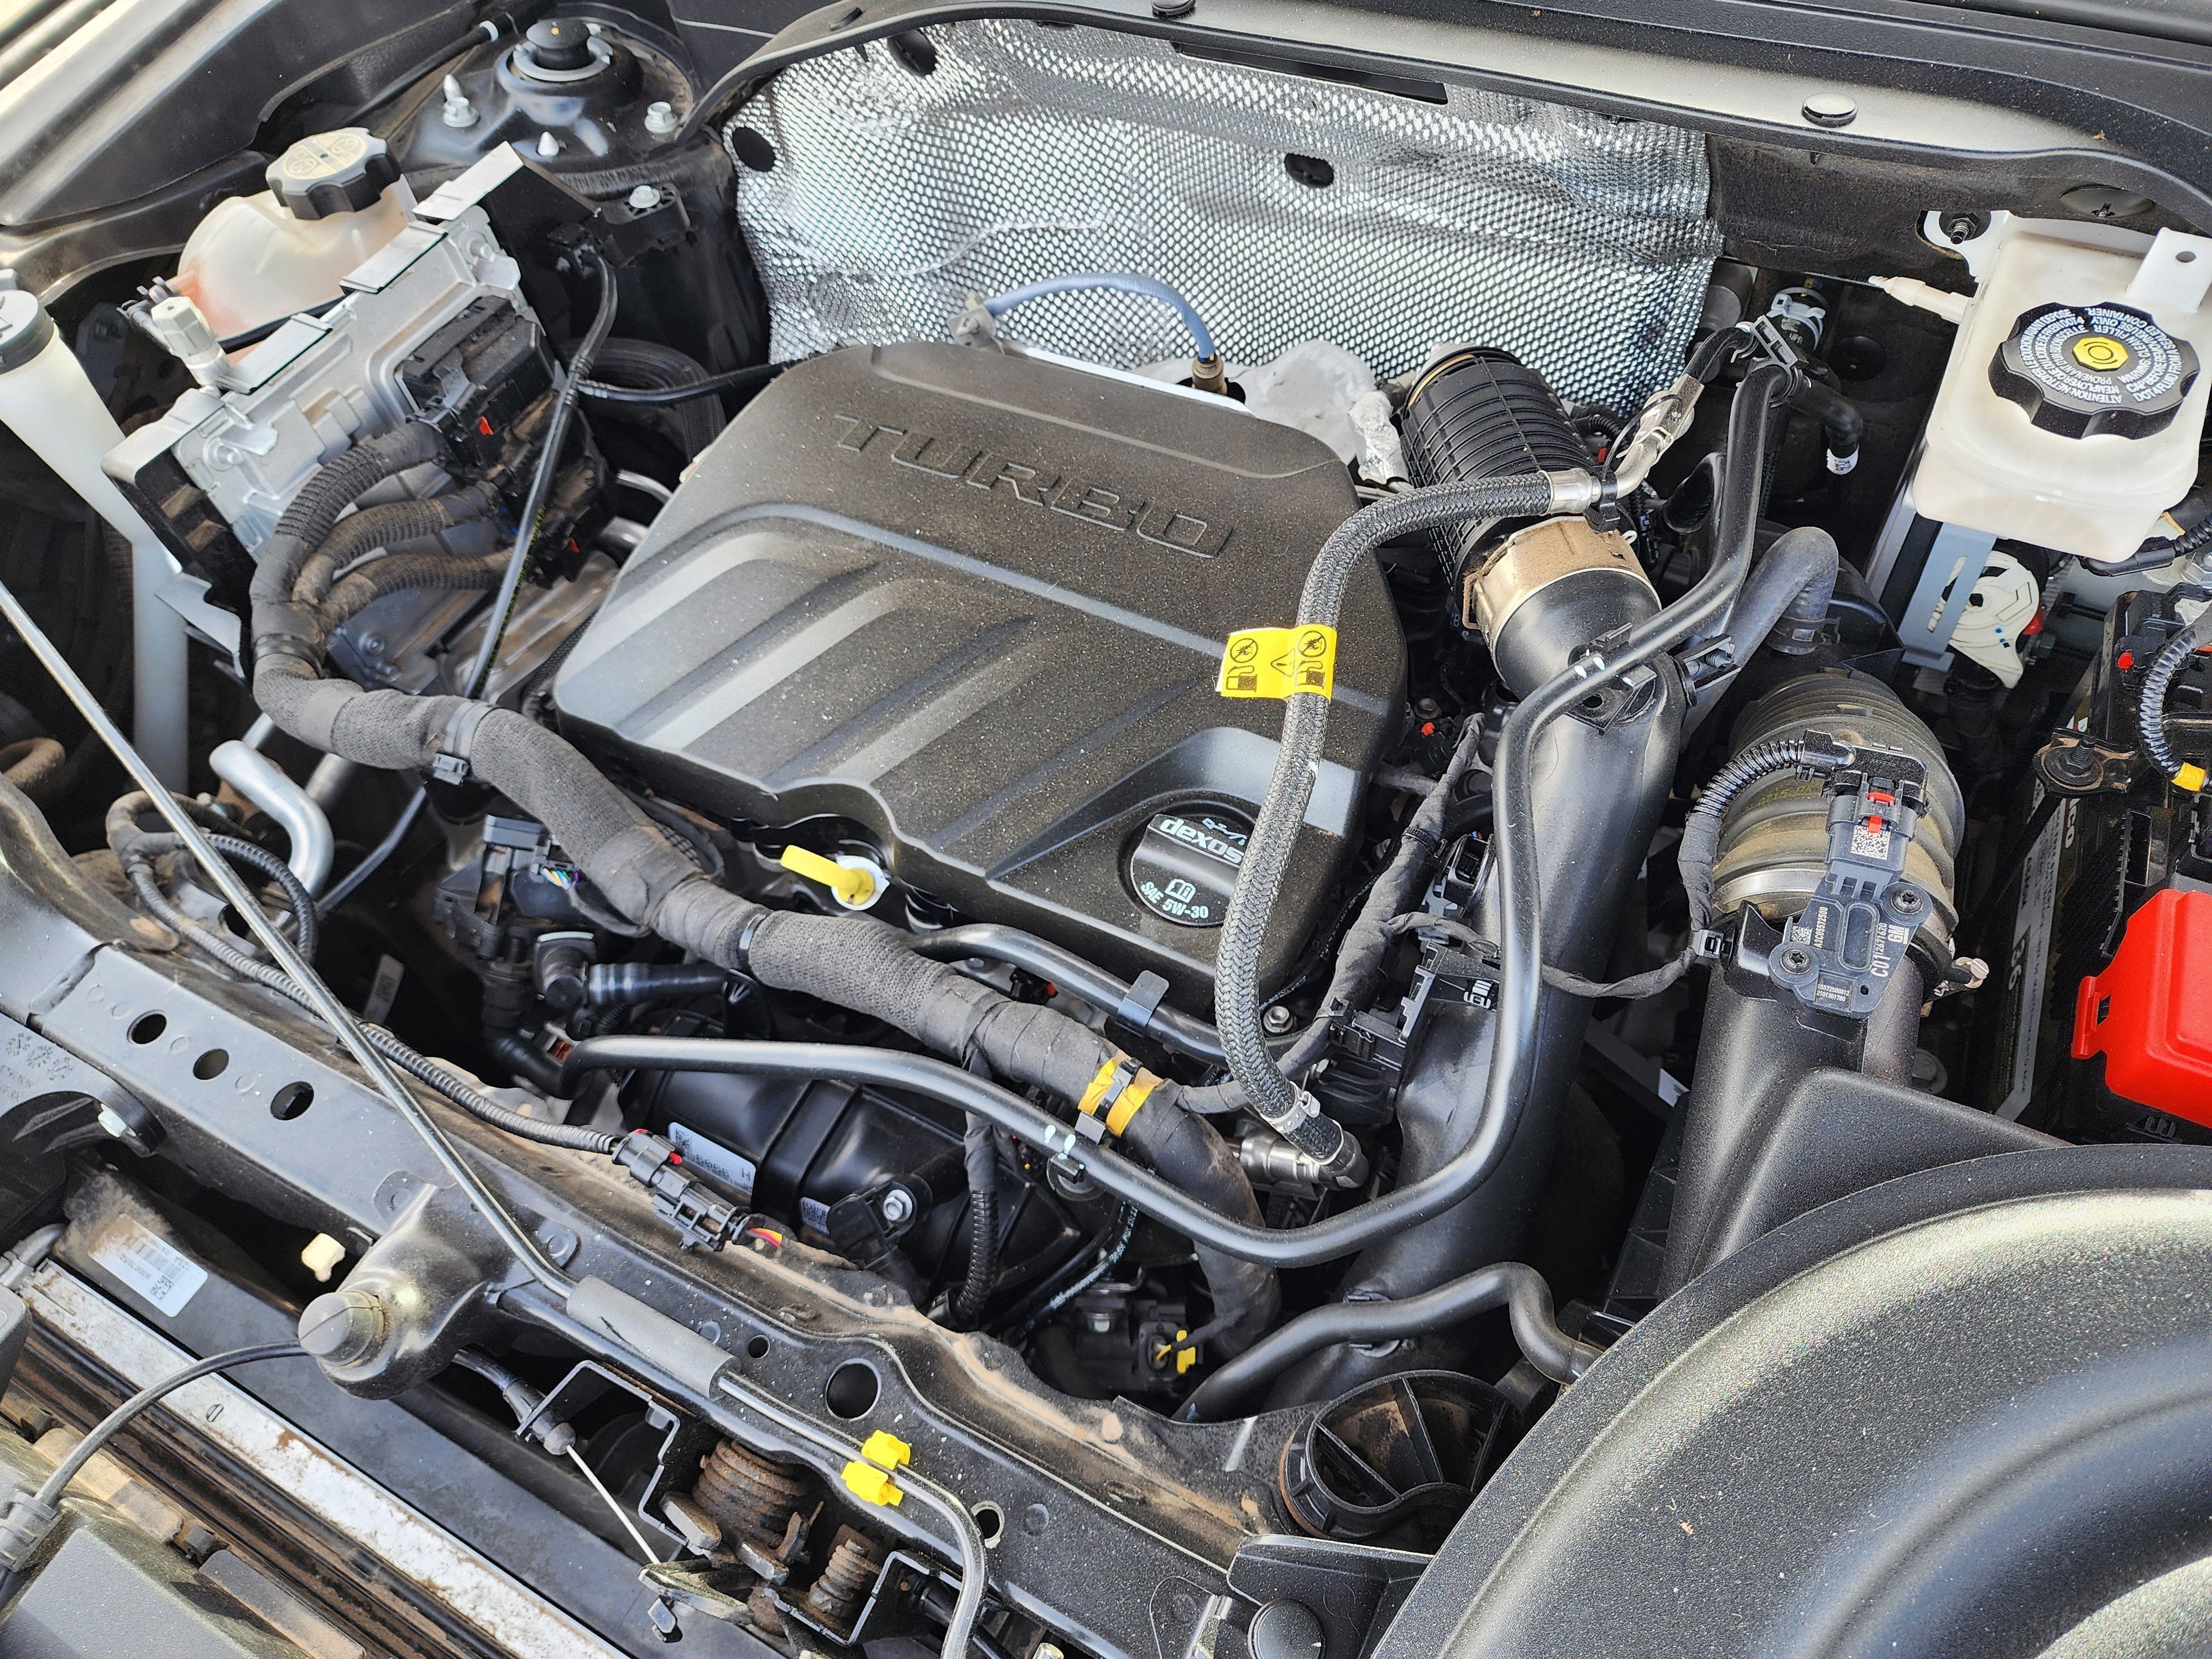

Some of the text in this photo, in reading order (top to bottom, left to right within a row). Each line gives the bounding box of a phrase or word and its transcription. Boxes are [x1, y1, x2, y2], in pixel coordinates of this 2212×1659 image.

[2024, 319, 2047, 335] AVANT
[2084, 307, 2148, 328] CONTAINER.
[2090, 316, 2119, 327] ONLY
[2036, 333, 2051, 343] DE
[2094, 325, 2130, 340] FILLER
[2117, 321, 2140, 335] USE
[2144, 325, 2177, 349] SEALED
[2020, 334, 2035, 361] BOUCHON
[2035, 341, 2050, 361] LIQUIDE
[2049, 336, 2065, 353] BIDON
[2125, 336, 2151, 358] CLEAN
[2024, 360, 2039, 369] LE
[2040, 361, 2056, 369] DU
[2047, 367, 2068, 380] QUE
[2142, 362, 2167, 385] BEFORE
[2168, 354, 2182, 374] FROM
[2031, 367, 2072, 394] NETTOYER
[2062, 366, 2112, 384] PROVENANT
[2155, 373, 2179, 392] FLUID
[2125, 380, 2146, 393] CAP
[834, 413, 1234, 559] TURBO
[1160, 818, 1245, 864] dexos
[1140, 881, 1209, 919] SAE 5W-30
[1813, 906, 1828, 948] A3C05572500
[1887, 924, 1907, 943] GM
[1875, 922, 1887, 955] 12671620
[2008, 939, 2025, 990] 36
